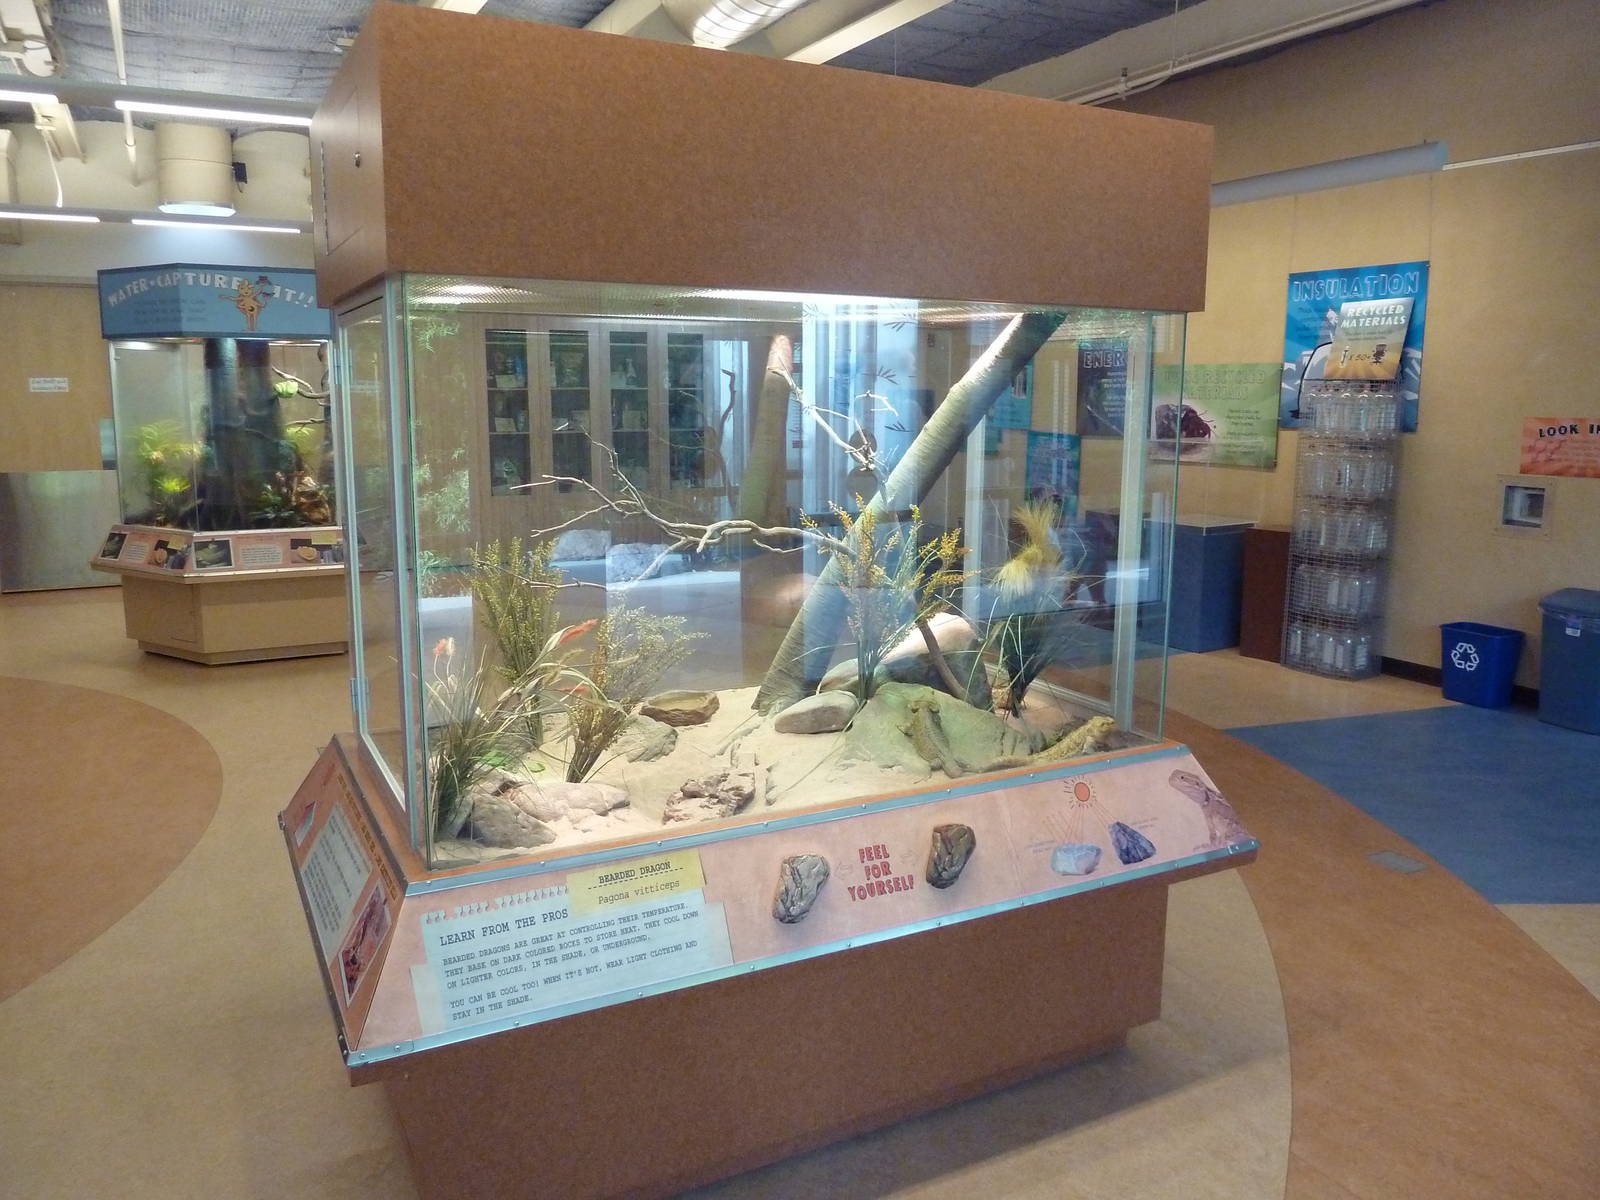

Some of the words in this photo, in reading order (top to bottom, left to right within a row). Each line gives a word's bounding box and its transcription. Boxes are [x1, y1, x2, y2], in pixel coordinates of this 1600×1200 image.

[1292, 272, 1420, 301] INSULATION
[1340, 316, 1406, 328] MATERIALS
[1348, 304, 1404, 317] RECYCLED
[1083, 350, 1127, 368] ENER
[1538, 424, 1580, 438] LOOK
[858, 844, 890, 863] FEEL
[598, 869, 636, 884] BEARDED
[640, 861, 671, 876] DRAGON
[864, 861, 892, 880] FOR
[598, 890, 630, 904] Pagona
[634, 880, 680, 896] vitticeps
[848, 874, 914, 902] YOURSELF
[440, 930, 475, 946] LEARN
[482, 922, 510, 936] FROM
[515, 916, 536, 929] THE
[542, 909, 568, 922] PROS
[444, 954, 476, 966] BEARDED
[480, 944, 510, 958] DRAGONS
[514, 940, 528, 949] ARE
[532, 934, 553, 944] GREAT
[556, 930, 566, 938] AT
[570, 920, 615, 936] CONTROLLING
[618, 914, 639, 924] THEIR
[642, 903, 688, 918] TEMPERATURE.
[445, 967, 464, 978] THEY
[468, 961, 486, 972] BASK
[490, 959, 500, 967] ON
[504, 954, 522, 964] DARK
[525, 946, 556, 958] COLORED
[559, 939, 580, 951] ROCKS
[584, 936, 593, 944] TO
[596, 930, 618, 941] STORE
[620, 926, 640, 936] HEAT.
[644, 920, 661, 930] THEY
[664, 916, 680, 926] COOL
[683, 910, 698, 920] DOWN
[446, 980, 457, 989] ON
[461, 972, 493, 986] LIGHTER
[496, 965, 527, 977] COLORS,
[532, 961, 540, 969] IN
[544, 956, 558, 965] THE
[562, 950, 586, 961] SHADE,
[590, 946, 600, 954] OR
[602, 934, 650, 951] UNDERGROUND.
[450, 1000, 464, 1008] YOU
[469, 994, 482, 1004] CAN
[487, 991, 496, 1000] BE
[500, 986, 518, 996] COOL
[522, 980, 539, 991] TOO!
[544, 974, 561, 984] WHEN
[566, 969, 582, 980] IT'S
[606, 959, 623, 969] WEAR
[627, 953, 646, 964] LIGHT
[650, 944, 682, 958] CLOTHING
[686, 940, 698, 949] AND
[452, 1010, 471, 1020] STAY
[476, 1006, 484, 1014] IN
[488, 1002, 503, 1012] THE
[507, 995, 533, 1006] SHADE.
